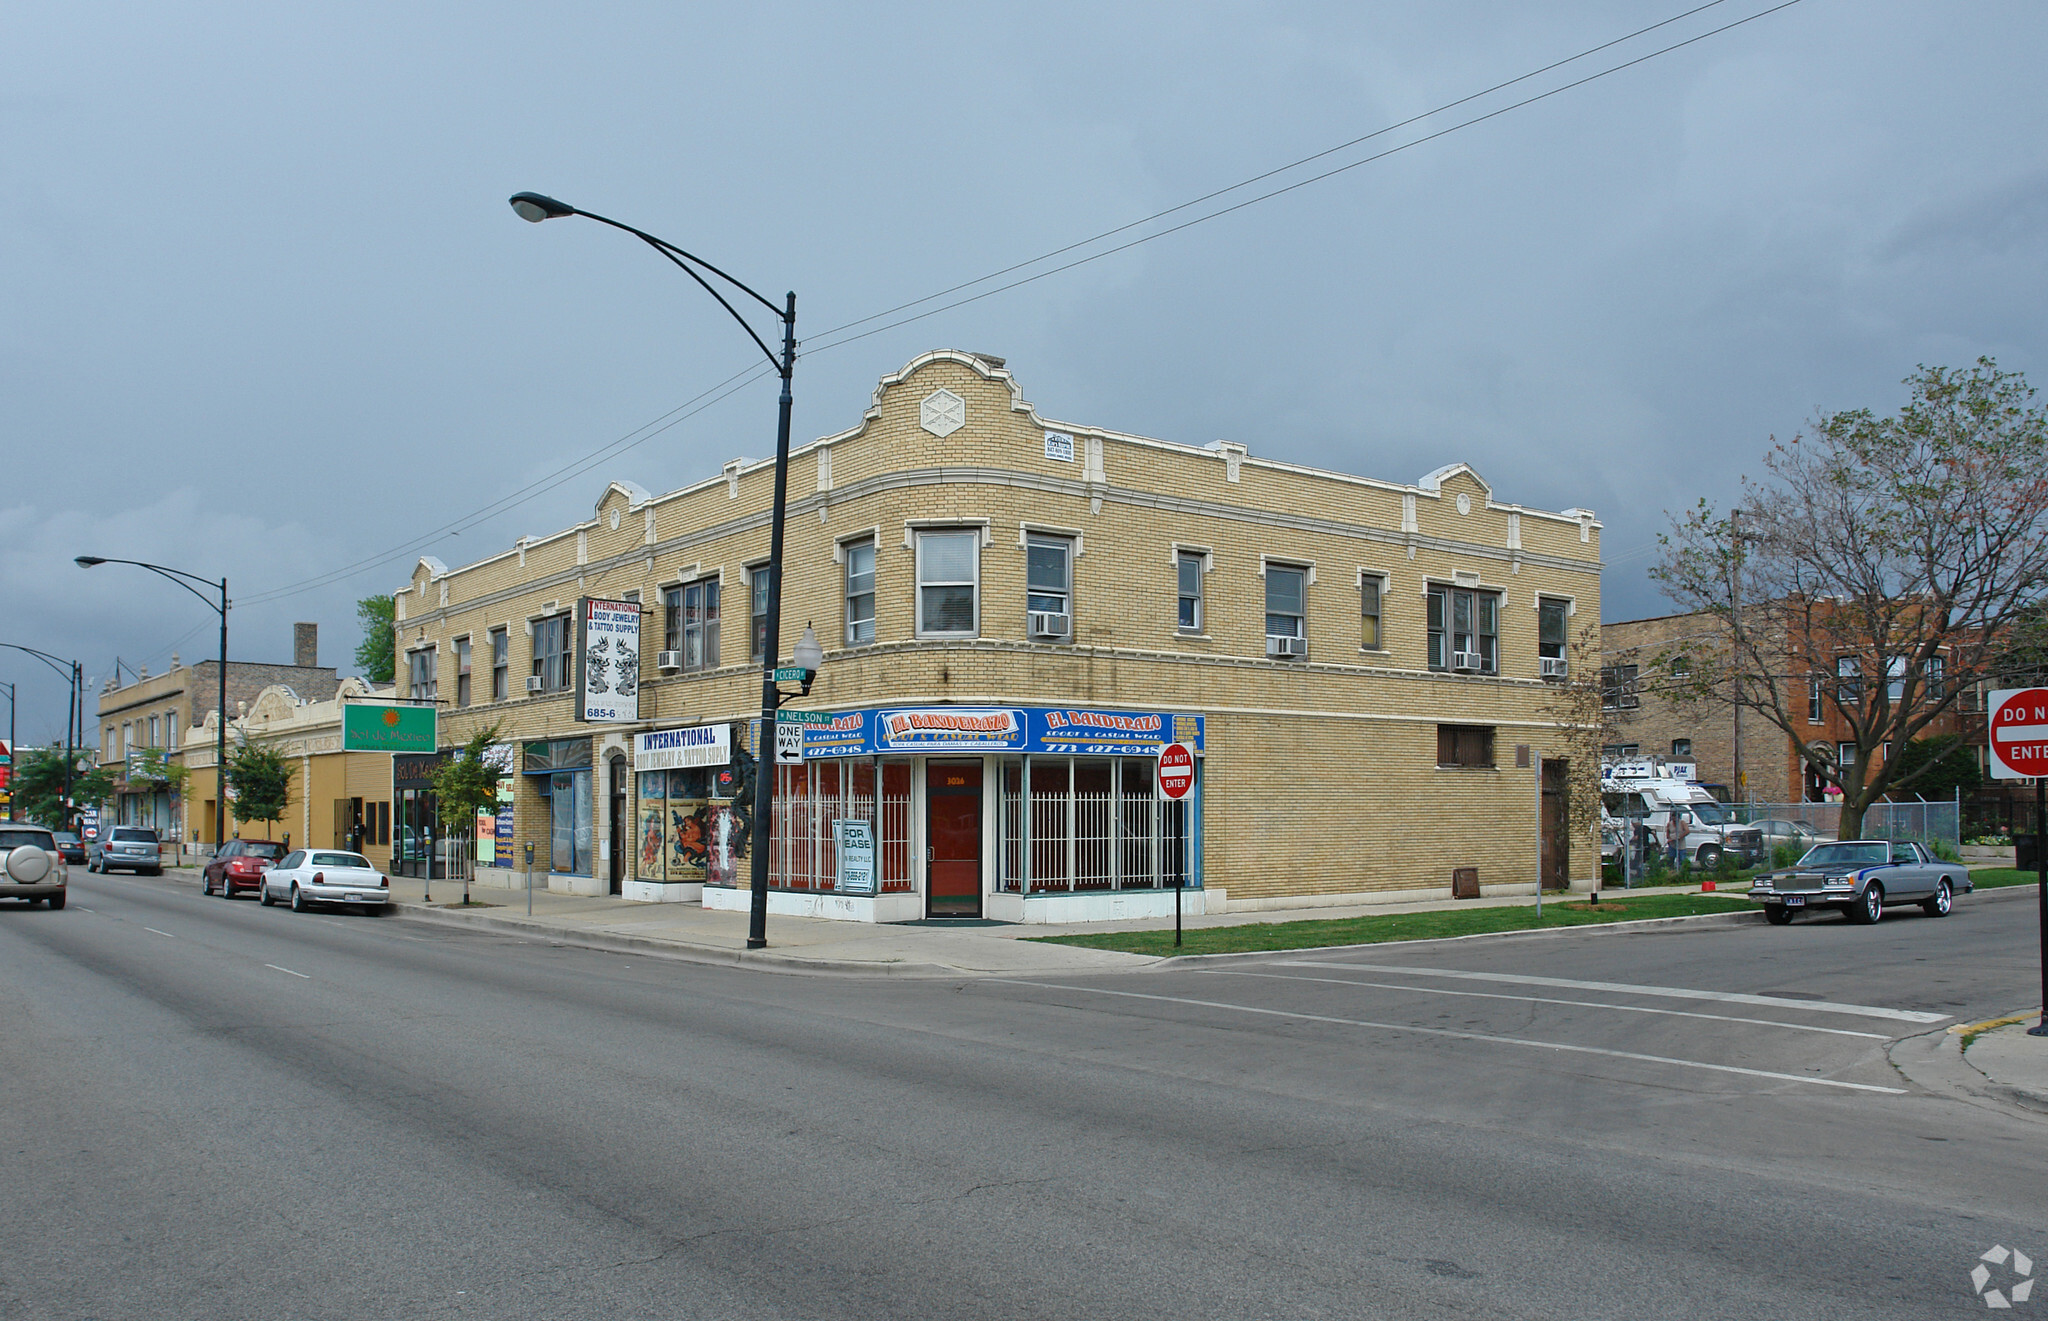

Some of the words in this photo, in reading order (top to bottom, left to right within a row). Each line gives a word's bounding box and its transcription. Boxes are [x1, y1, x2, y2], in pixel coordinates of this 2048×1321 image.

[588, 601, 640, 619] INTERNATIONAL
[594, 612, 610, 621] BODY
[612, 613, 639, 623] JEWELRY
[588, 622, 592, 630] &
[594, 622, 613, 632] TATTOO
[615, 624, 639, 634] SUPPLY
[780, 670, 800, 680] CICERO
[786, 712, 822, 722] NELSON
[2003, 707, 2026, 721] DO
[2034, 706, 2048, 720] N
[891, 715, 910, 733] EL
[910, 713, 1010, 731] BANDERAZO
[1045, 711, 1069, 729] EL
[1067, 711, 1161, 731] BANDERAZO
[779, 726, 800, 736] ONE
[644, 727, 716, 750] INTERNATIONAL
[778, 737, 800, 747] WAY
[933, 733, 980, 741] CASUAL
[986, 733, 1019, 741] WEAR
[807, 745, 862, 755] 427-6948
[1046, 744, 1077, 752] 773
[1085, 745, 1160, 754] 427-6948
[684, 748, 707, 766] TATTOO
[1163, 755, 1172, 764] DO
[1174, 754, 1187, 764] NOT
[1166, 779, 1186, 788] ENTER
[839, 839, 870, 849] EASE
